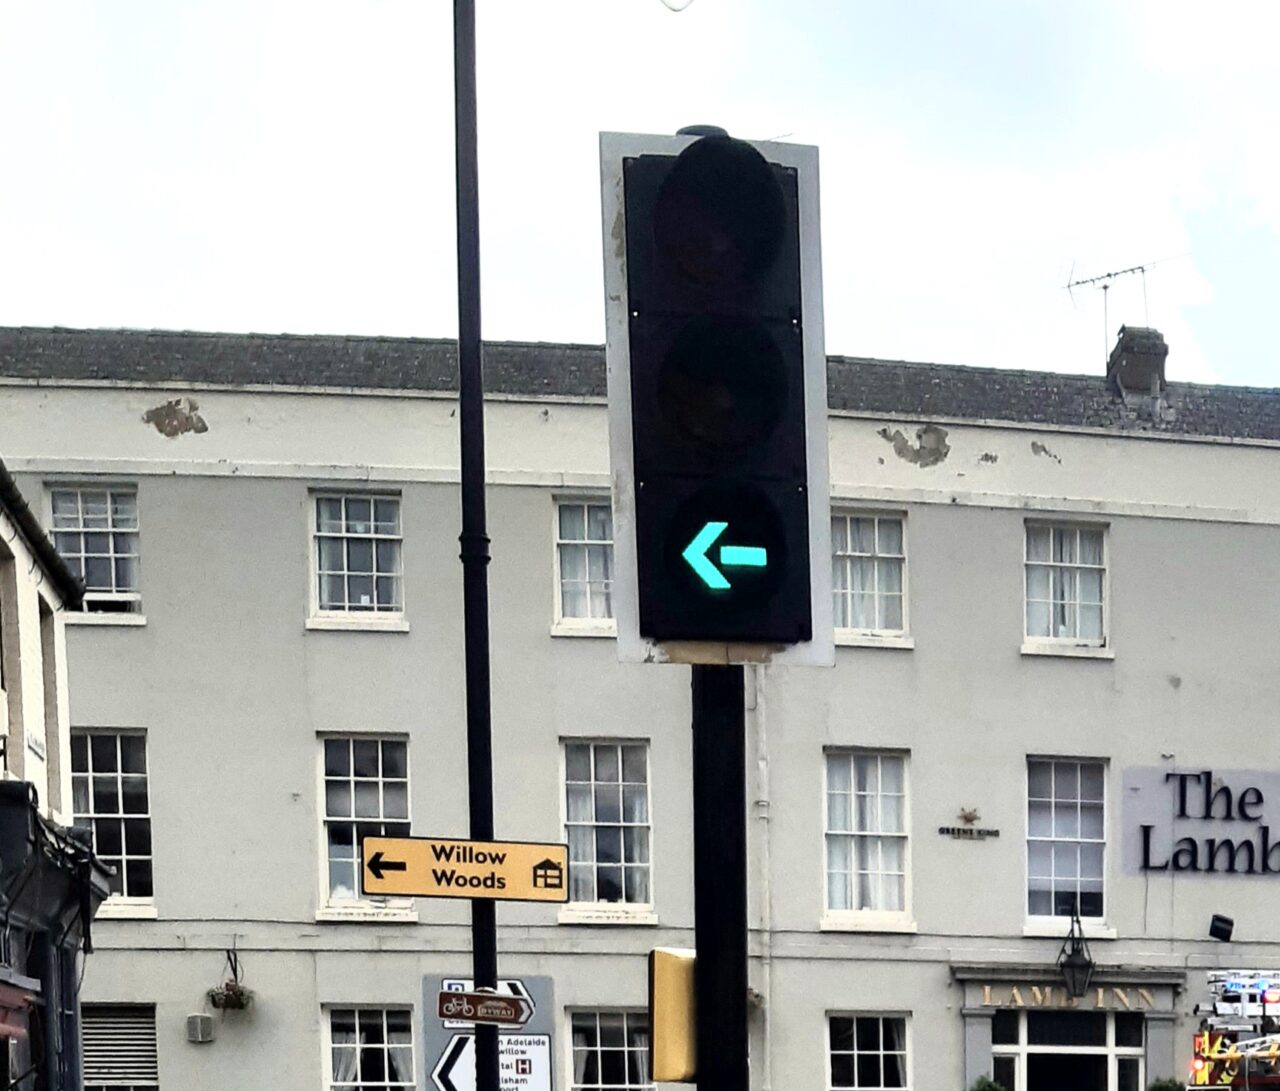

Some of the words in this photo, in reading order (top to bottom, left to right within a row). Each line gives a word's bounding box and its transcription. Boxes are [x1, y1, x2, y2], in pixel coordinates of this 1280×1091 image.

[1165, 771, 1264, 821] The
[430, 844, 507, 865] Willow
[431, 868, 506, 889] Woods
[1096, 987, 1156, 1010] INN
[507, 1037, 546, 1047] Adelaide
